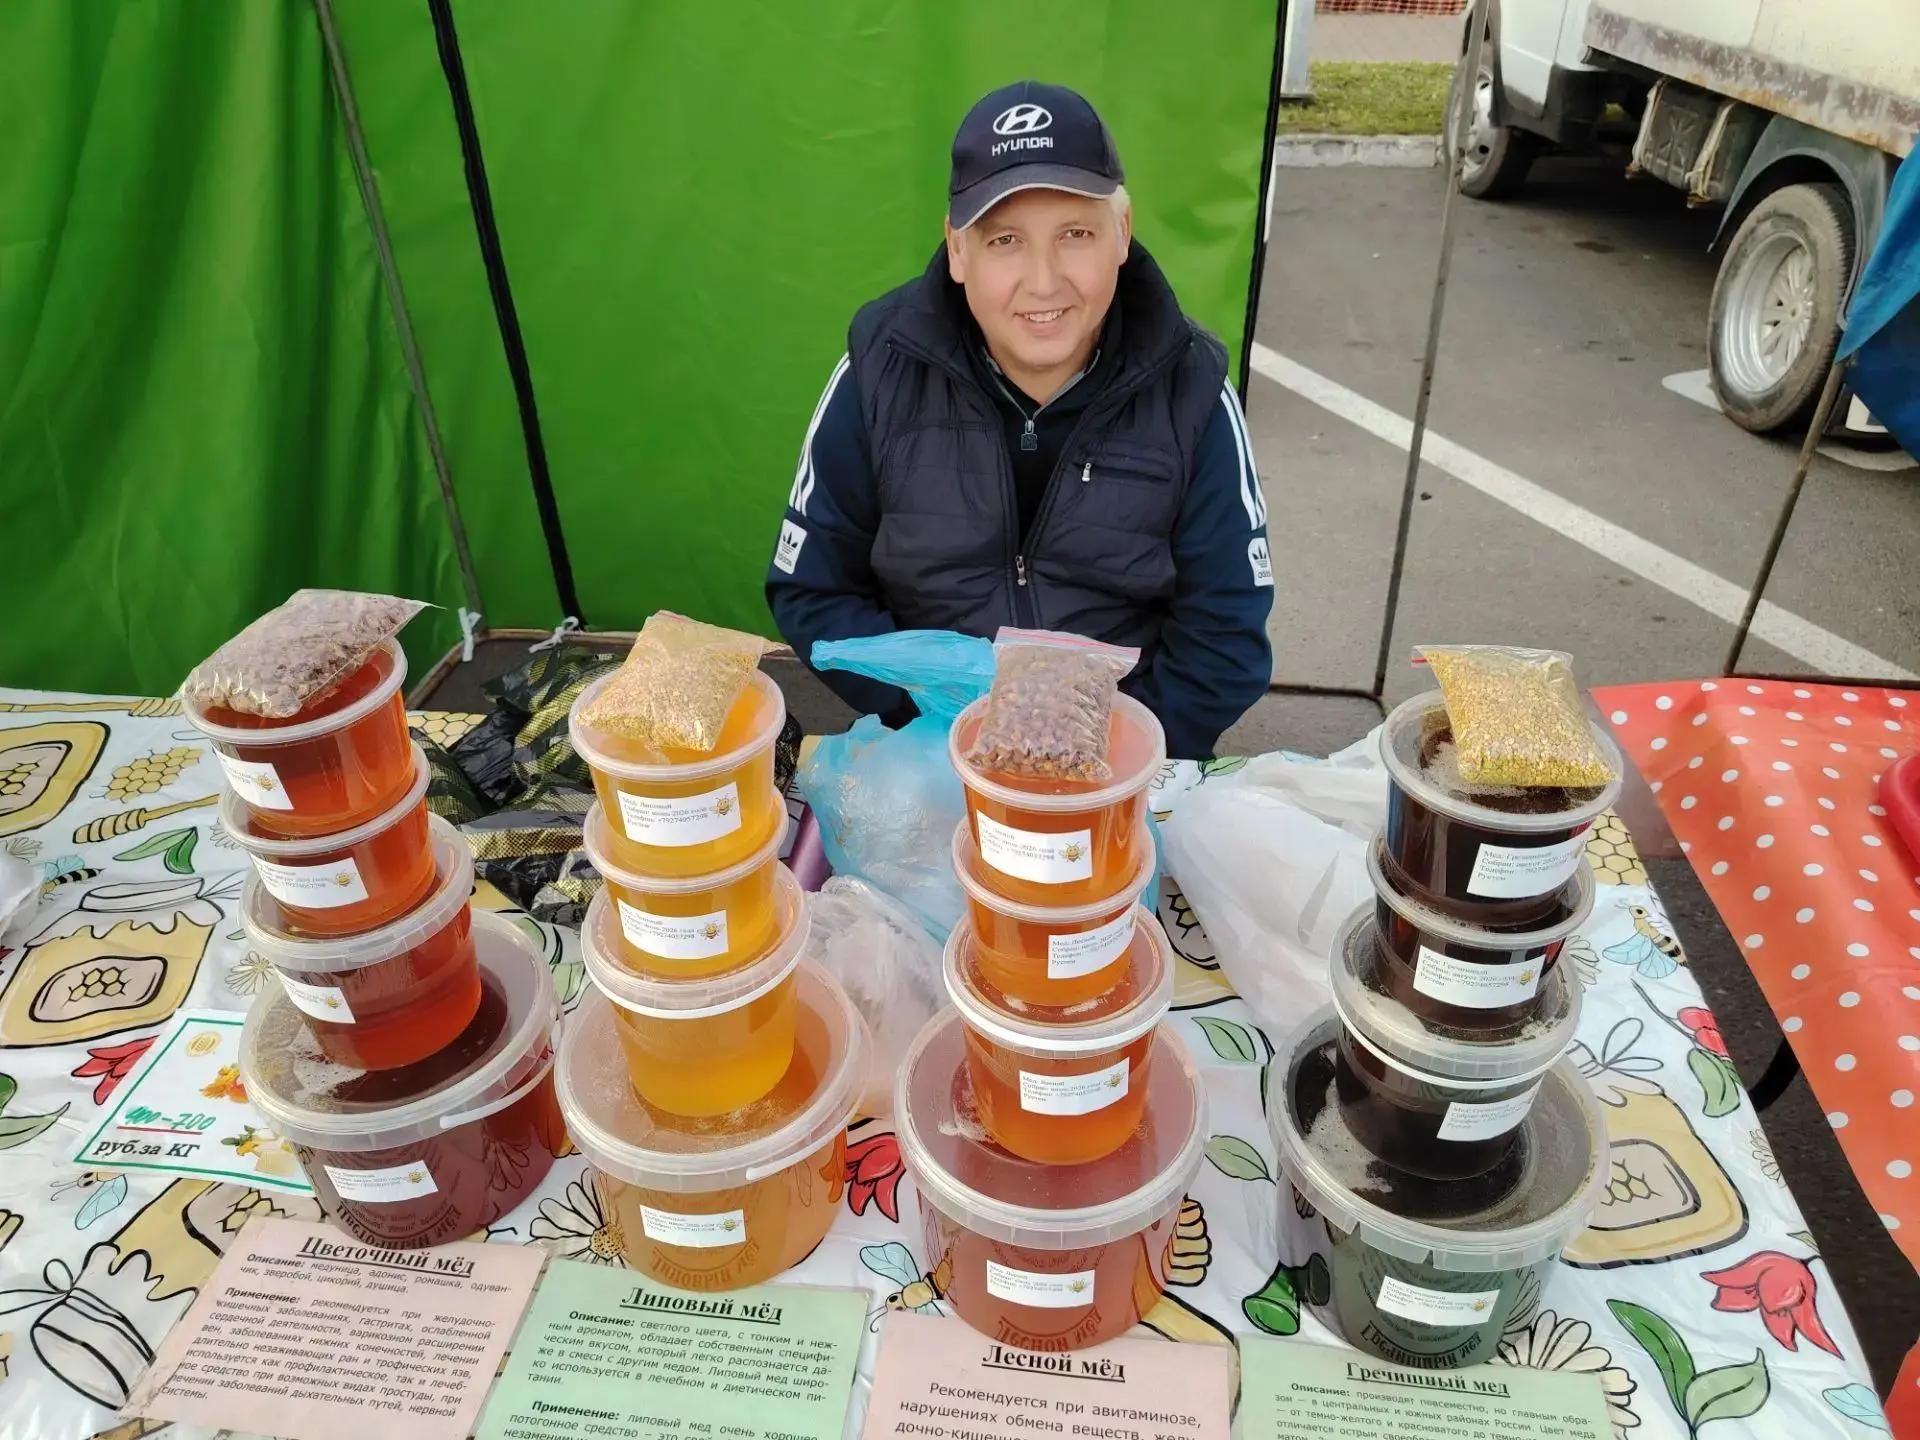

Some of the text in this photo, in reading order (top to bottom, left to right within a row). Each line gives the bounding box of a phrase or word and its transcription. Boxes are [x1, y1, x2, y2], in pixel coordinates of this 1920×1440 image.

[992, 137, 1054, 156] HYUNDAI
[166, 1143, 200, 1158] КГ
[245, 1252, 306, 1268] Описание:
[299, 1236, 475, 1275] Цветочный мёд
[224, 1286, 301, 1304] Применение:
[309, 1298, 390, 1315] рекомендуется
[400, 1310, 422, 1320] при
[621, 1287, 783, 1322] Липовый мёд
[208, 1311, 266, 1325] сердечной
[348, 1328, 414, 1344] варикозном
[415, 1337, 486, 1353] расширении
[420, 1325, 492, 1341] ослабленной
[547, 1322, 573, 1331] ным
[639, 1331, 694, 1346] обладает
[697, 1339, 774, 1356] собственным
[568, 1309, 636, 1327] Описание:
[639, 1320, 690, 1334] светлого
[750, 1333, 791, 1345] тонким
[191, 1336, 250, 1350] длительно
[251, 1343, 336, 1361] незаживающих
[336, 1353, 360, 1364] ран
[375, 1358, 447, 1376] трофических
[228, 1326, 305, 1344] заболеваниях
[307, 1336, 351, 1349] нижних
[432, 1352, 480, 1366] лечении
[543, 1334, 584, 1346] ческим
[636, 1345, 687, 1359] который
[689, 1351, 724, 1364] легко
[727, 1356, 809, 1373] распознается
[981, 1344, 1125, 1380] Лесной мёд
[185, 1348, 258, 1364] используется
[260, 1357, 282, 1368] как
[395, 1374, 415, 1385] так
[531, 1359, 547, 1369] ко
[550, 1361, 631, 1379] используется
[647, 1373, 705, 1389] лечебном
[721, 1383, 801, 1400] диетическом
[537, 1346, 554, 1356] же
[567, 1350, 603, 1362] смеси
[615, 1355, 659, 1369] другим
[706, 1365, 761, 1381] Липовый
[765, 1373, 788, 1385] мед
[1346, 1361, 1510, 1397] Гречишный мед
[200, 1363, 250, 1377] средство
[251, 1370, 275, 1381] при
[276, 1373, 340, 1388] возможных
[341, 1381, 376, 1393] видах
[439, 1394, 463, 1405] при
[216, 1379, 290, 1396] заболеваний
[288, 1388, 366, 1406] дыхательных
[407, 1404, 456, 1418] нервной
[531, 1400, 620, 1421] Применение:
[626, 1413, 681, 1429] липовый
[688, 1421, 712, 1433] мед
[719, 1425, 755, 1438] очень
[899, 1400, 998, 1423] нарушениях
[1005, 1413, 1064, 1432] обмена
[928, 1381, 1201, 1429] Рекомендуется при авитаминозе,
[509, 1414, 578, 1430] потогонное
[584, 1423, 639, 1439] средство
